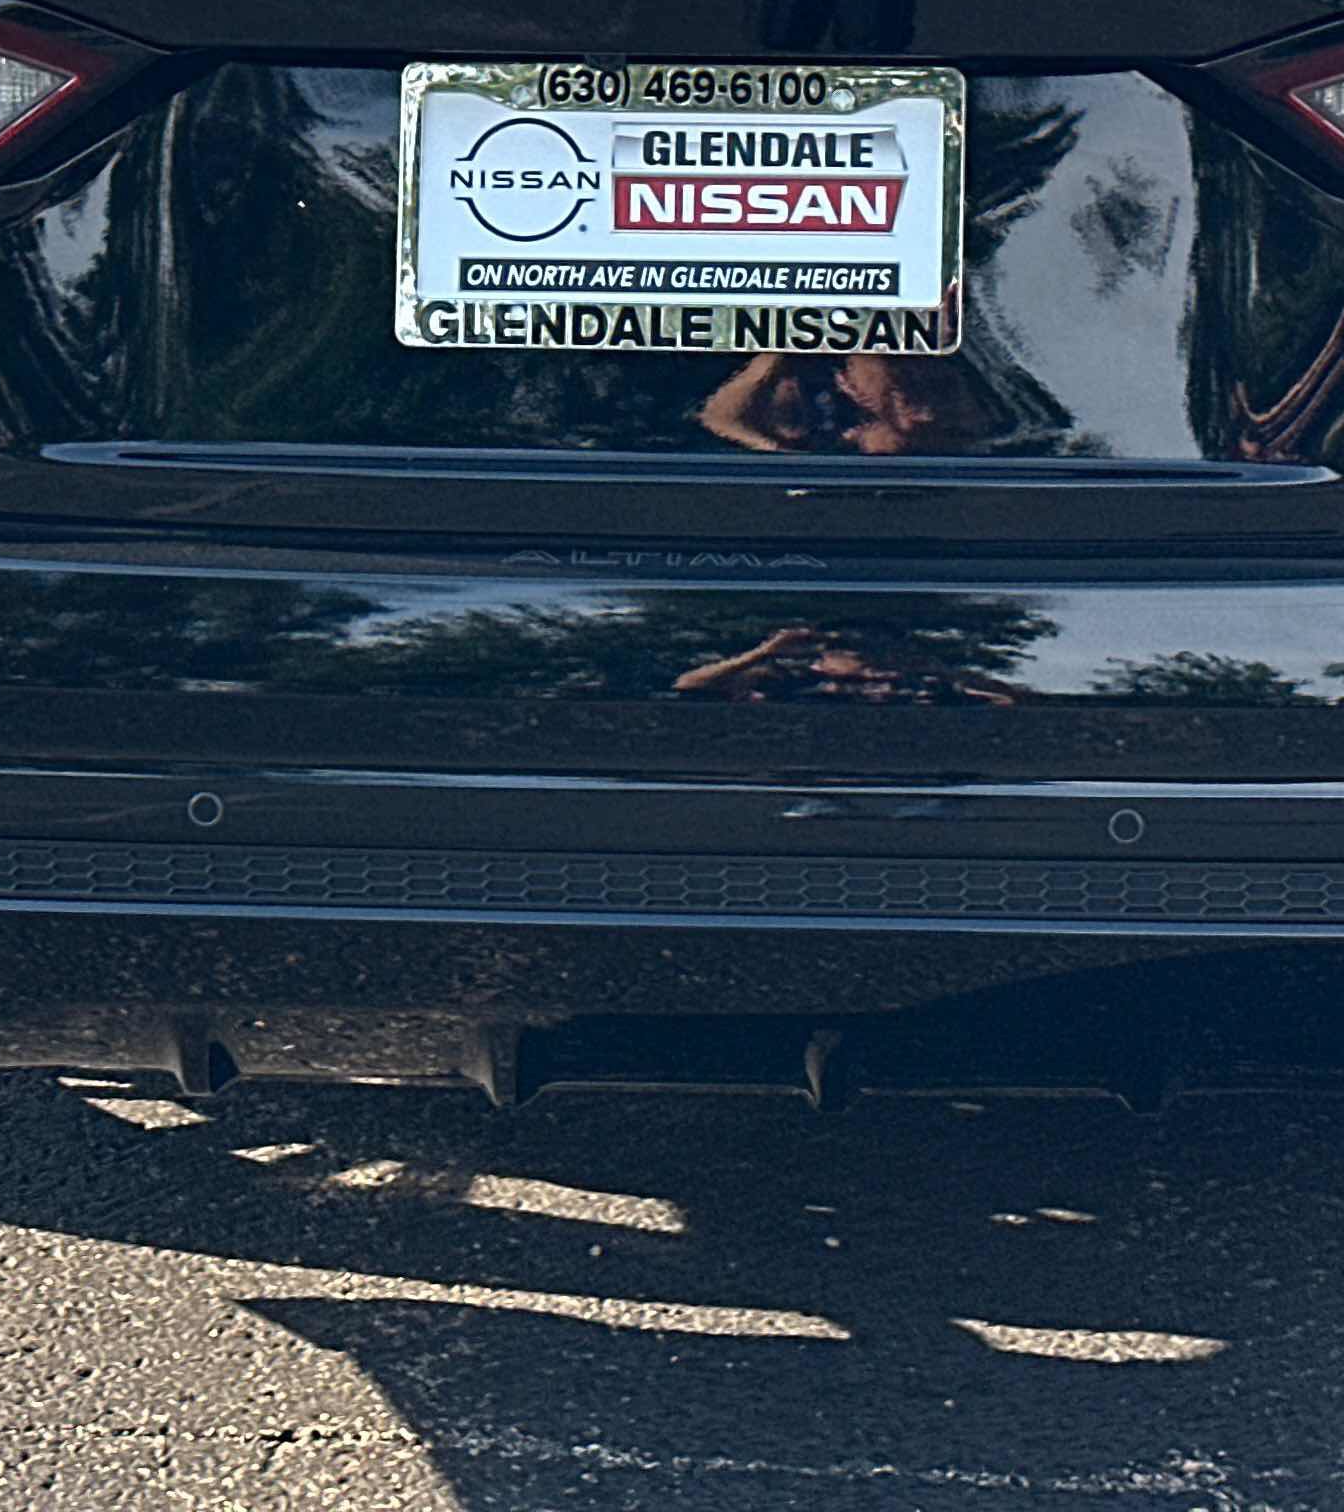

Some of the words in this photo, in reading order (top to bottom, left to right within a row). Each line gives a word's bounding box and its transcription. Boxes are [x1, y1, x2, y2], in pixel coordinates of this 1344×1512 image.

[537, 65, 631, 107] (630)
[643, 70, 826, 106] 469-6100
[643, 130, 874, 168] GLENDALE
[450, 170, 600, 189] NISSAN
[629, 183, 887, 225] NISSAN
[466, 264, 502, 286] ON
[506, 265, 585, 287] NORTH
[589, 266, 635, 287] AVE
[640, 267, 665, 287] IN
[670, 267, 790, 289] GLENDALE
[795, 269, 892, 290] HEIGHTS
[419, 301, 713, 348] GLENDALE
[734, 307, 939, 351] NISSAN
[501, 548, 827, 569] ALTIMA
